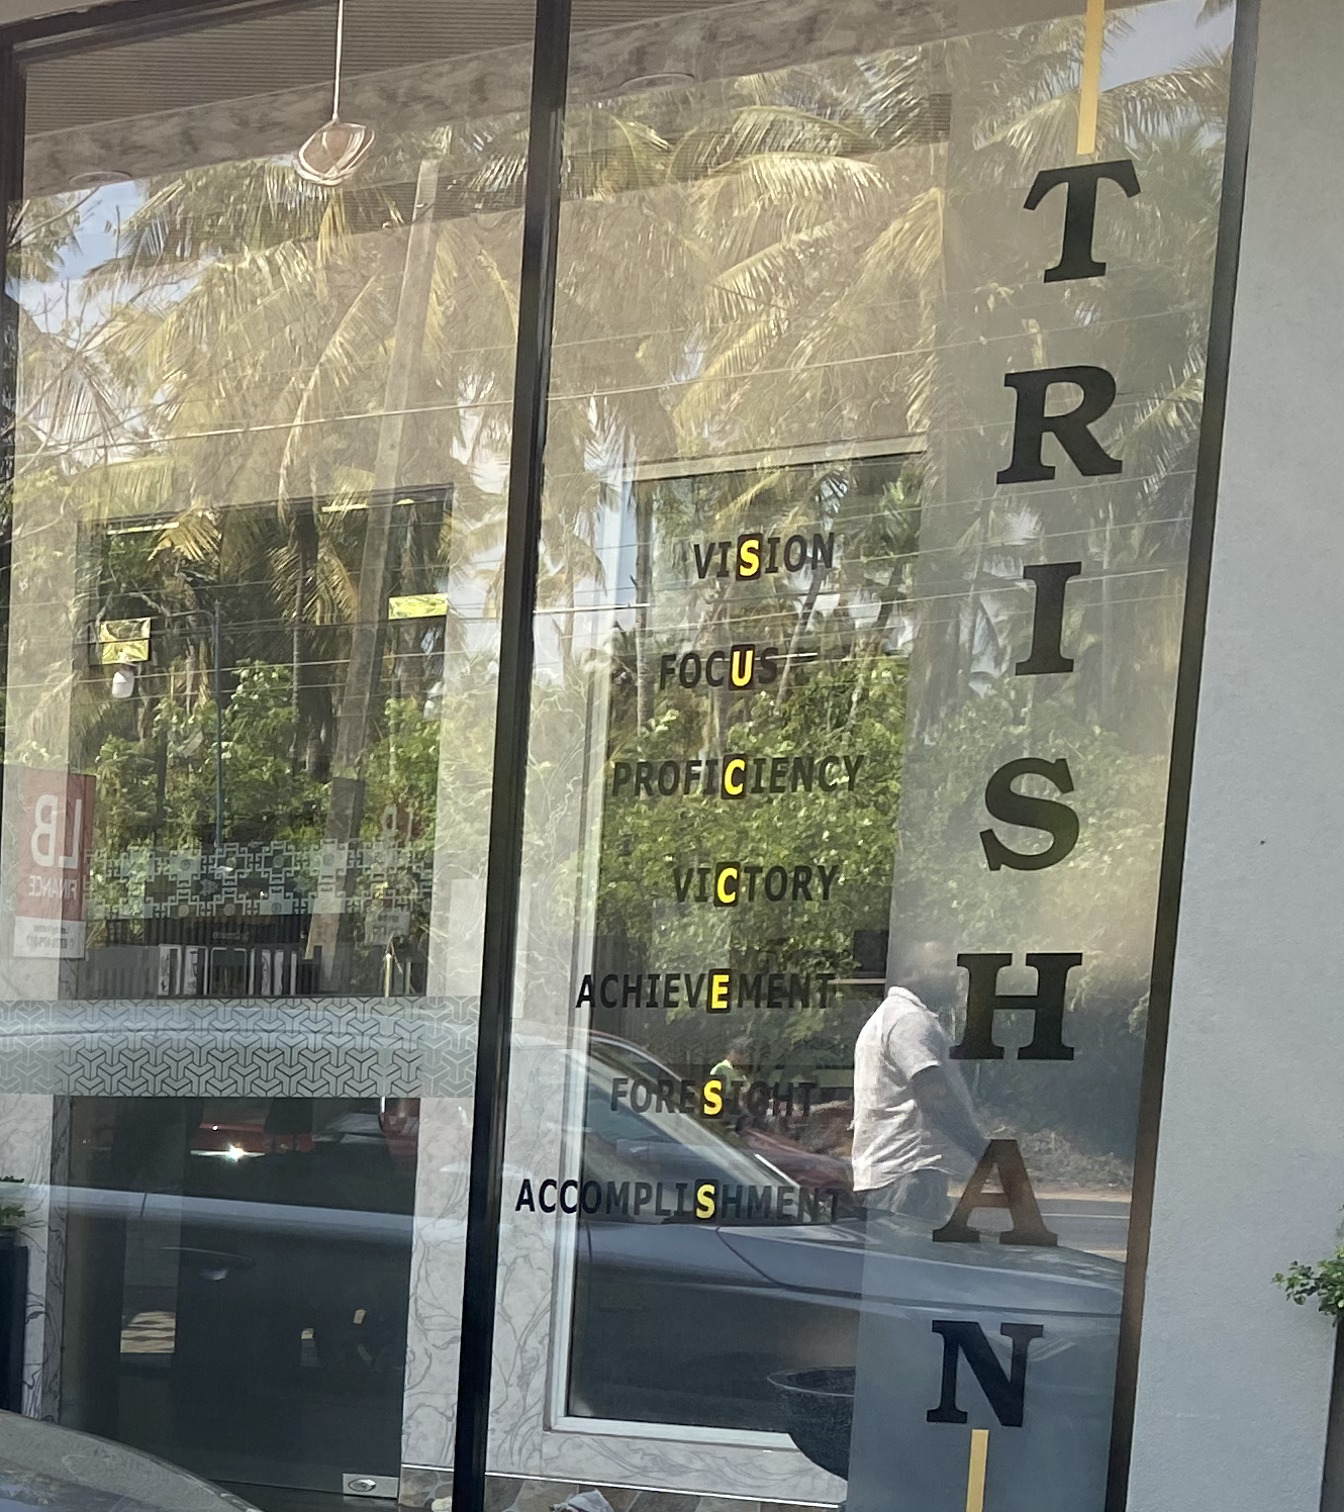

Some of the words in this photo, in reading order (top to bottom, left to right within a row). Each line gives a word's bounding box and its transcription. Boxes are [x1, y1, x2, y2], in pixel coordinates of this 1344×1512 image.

[693, 531, 836, 582] VISION
[659, 643, 779, 691] FOCUS
[612, 752, 865, 800] PROFICIENCY
[672, 861, 839, 907] VICTORY
[576, 968, 836, 1013] ACHIEVEMENT
[610, 1075, 818, 1118] FORESIGHT
[514, 1177, 840, 1224] ACCOMPLISHMENT
